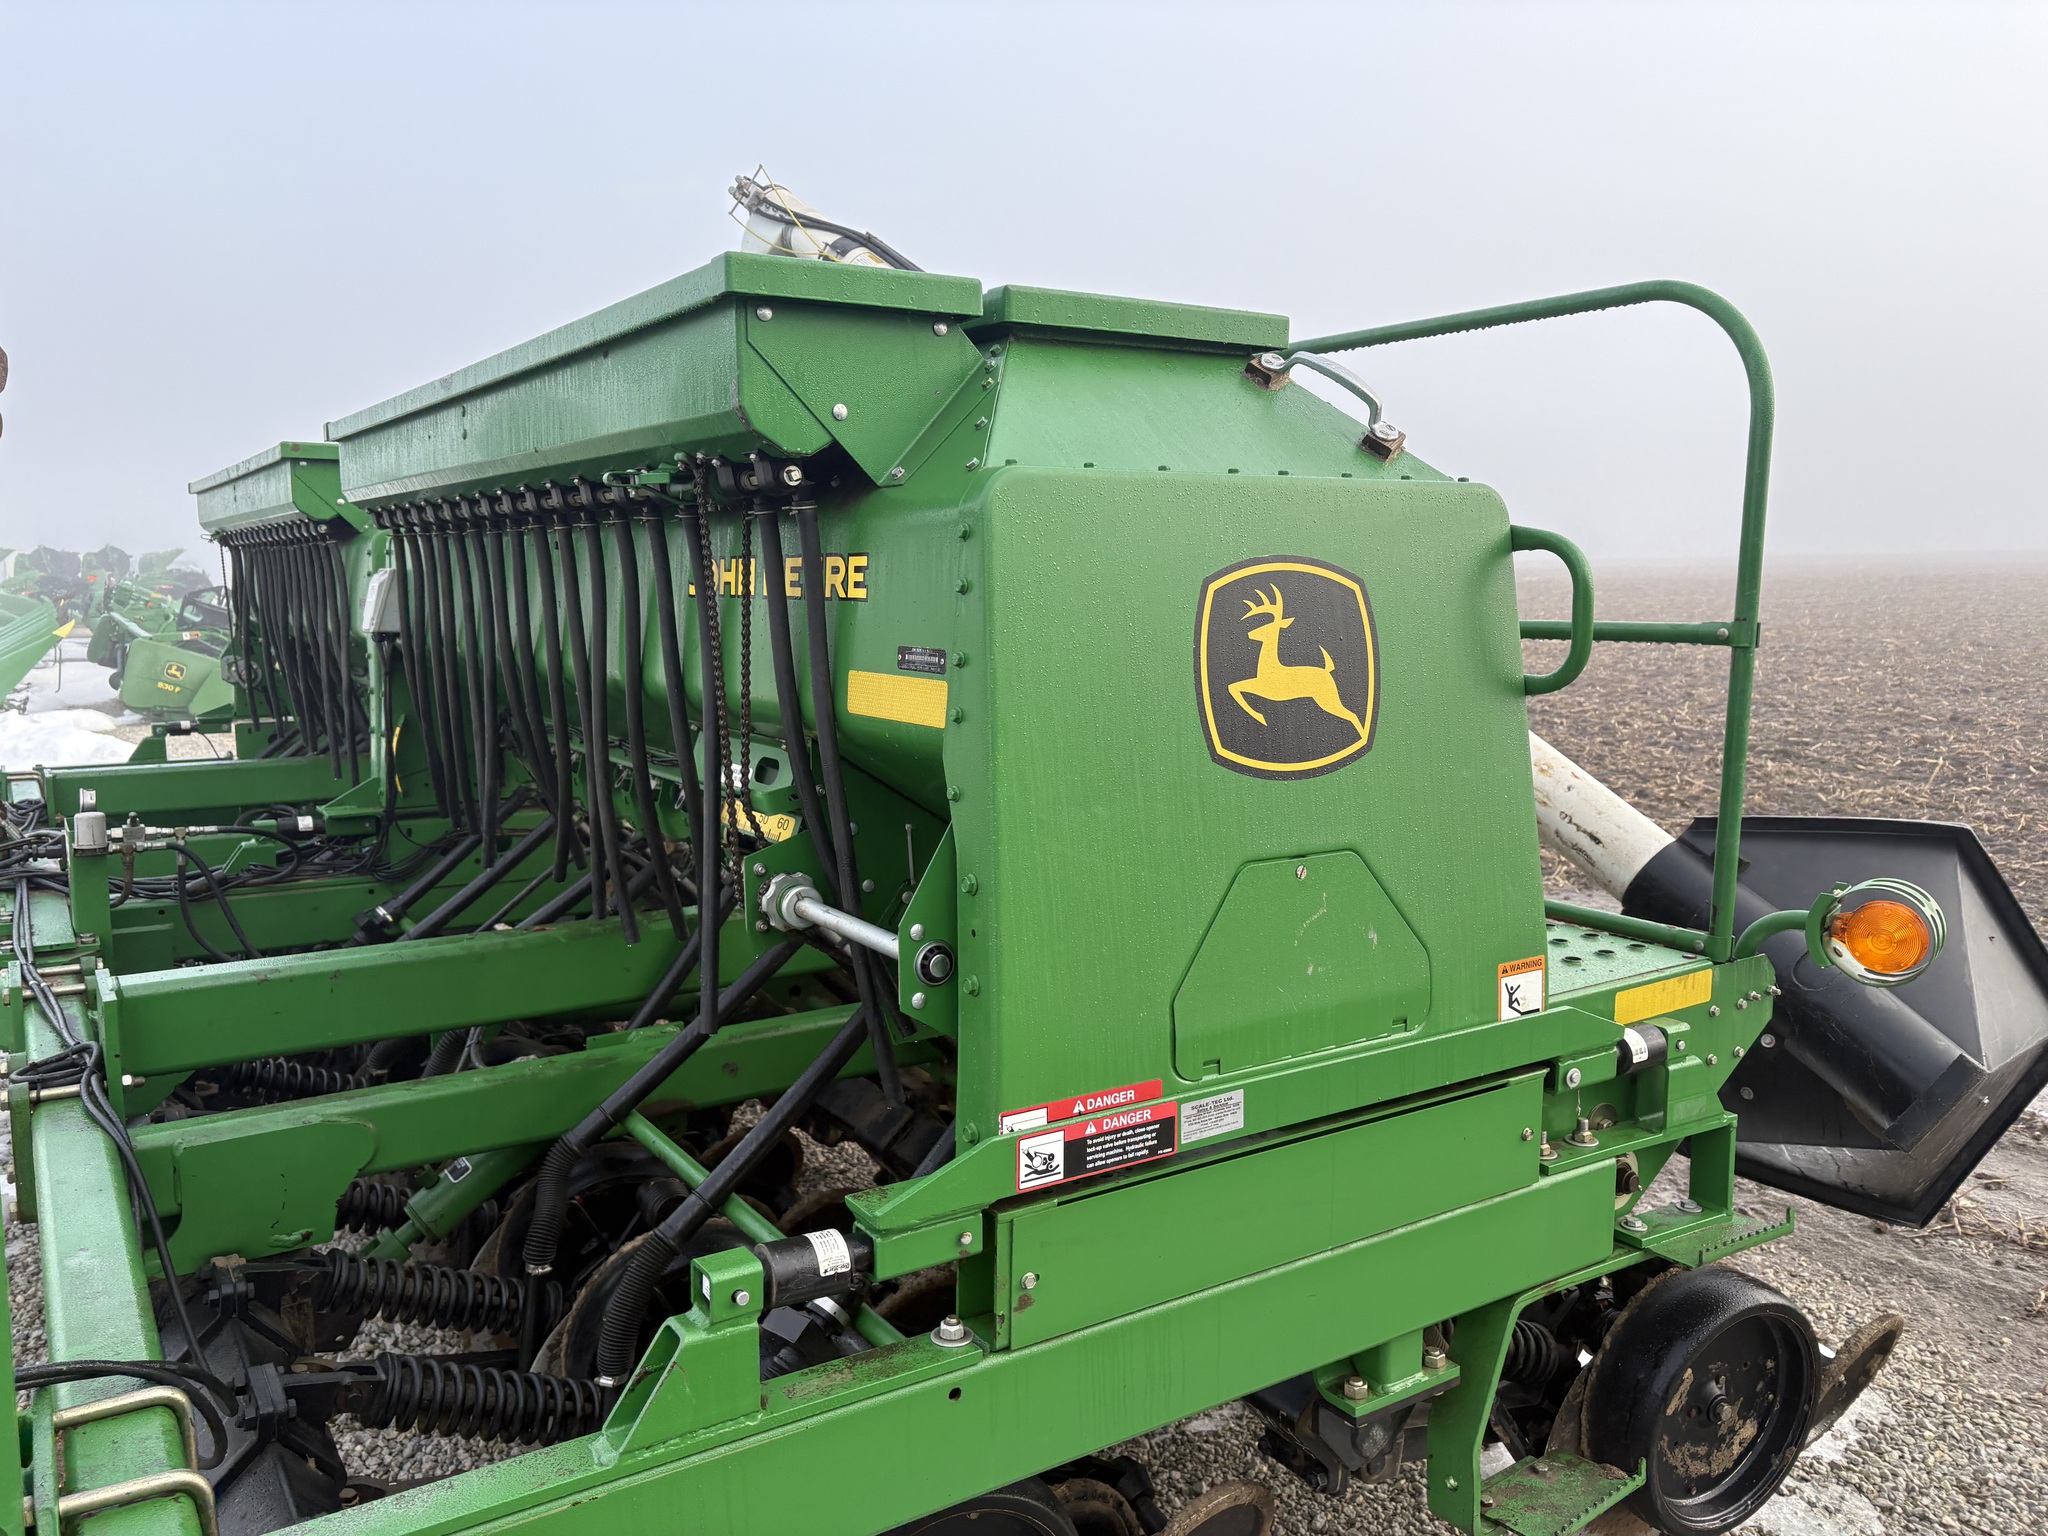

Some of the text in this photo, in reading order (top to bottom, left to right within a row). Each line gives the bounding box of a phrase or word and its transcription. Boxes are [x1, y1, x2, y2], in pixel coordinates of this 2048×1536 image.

[763, 554, 869, 600] ERE
[777, 818, 789, 830] 60
[1510, 959, 1542, 972] WARNING
[1087, 1090, 1135, 1110] DANGER
[1103, 1109, 1151, 1130] DANGER
[1087, 1144, 1102, 1152] lock-up
[1127, 1133, 1151, 1143] transporting
[1087, 1152, 1105, 1161] servicing
[1126, 1142, 1144, 1151] Hydraulic
[1106, 1155, 1122, 1164] openers
